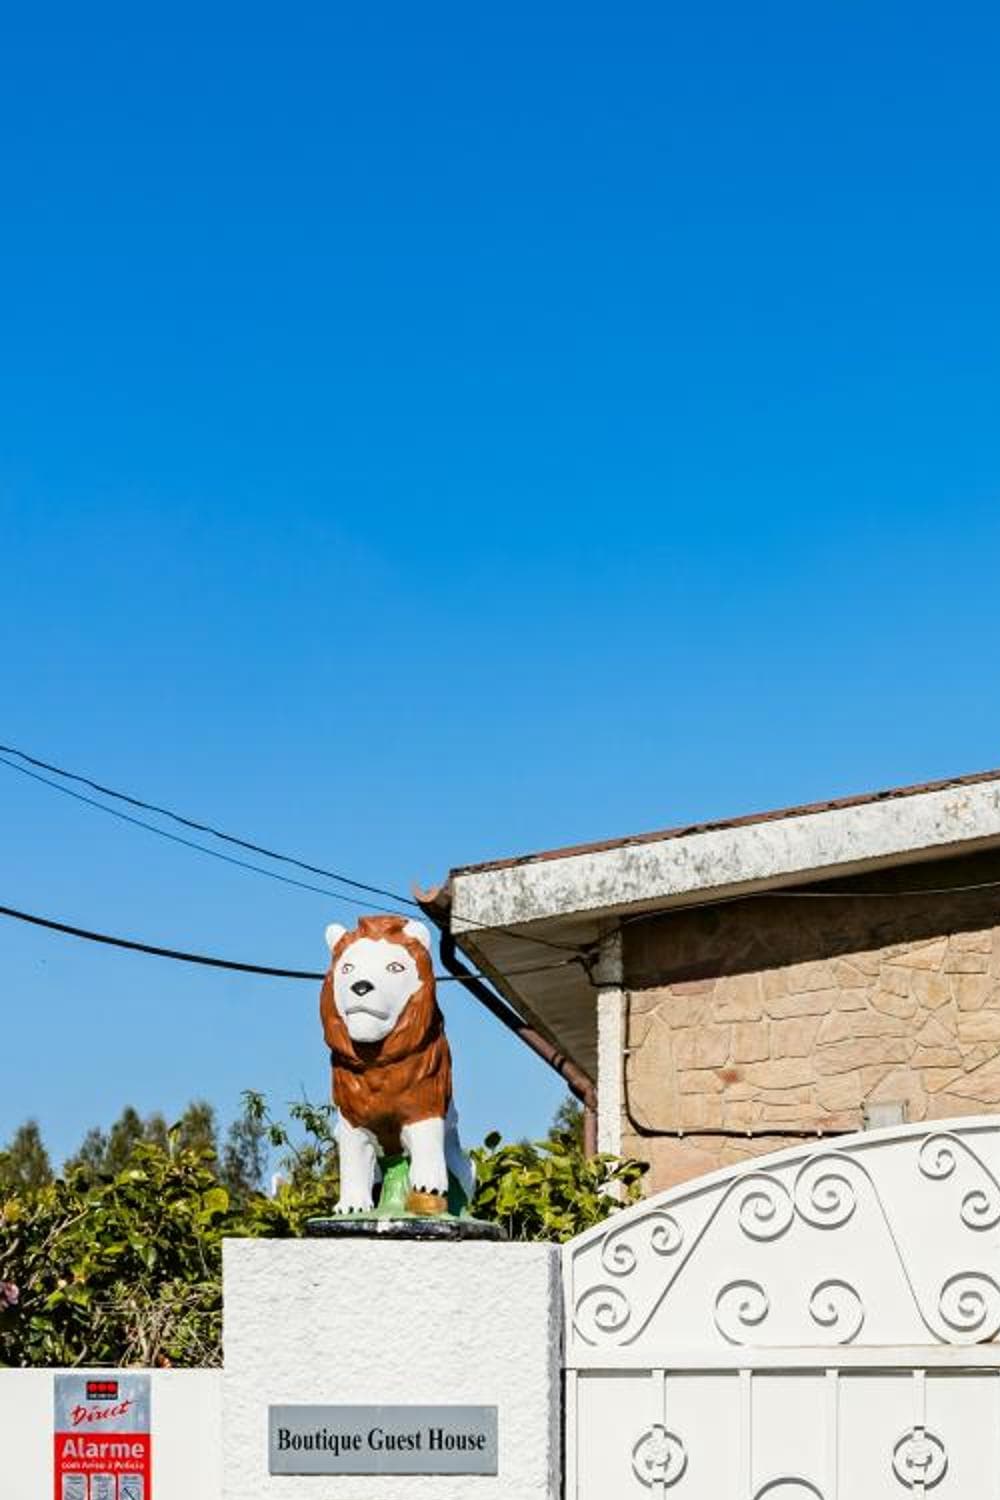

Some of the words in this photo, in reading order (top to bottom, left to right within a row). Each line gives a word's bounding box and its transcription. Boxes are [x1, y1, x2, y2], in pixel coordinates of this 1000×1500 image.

[71, 1399, 132, 1426] Direct
[61, 1437, 145, 1458] Alarme
[278, 1428, 362, 1456] Boutique
[367, 1427, 421, 1451] Guest
[428, 1428, 487, 1451] House
